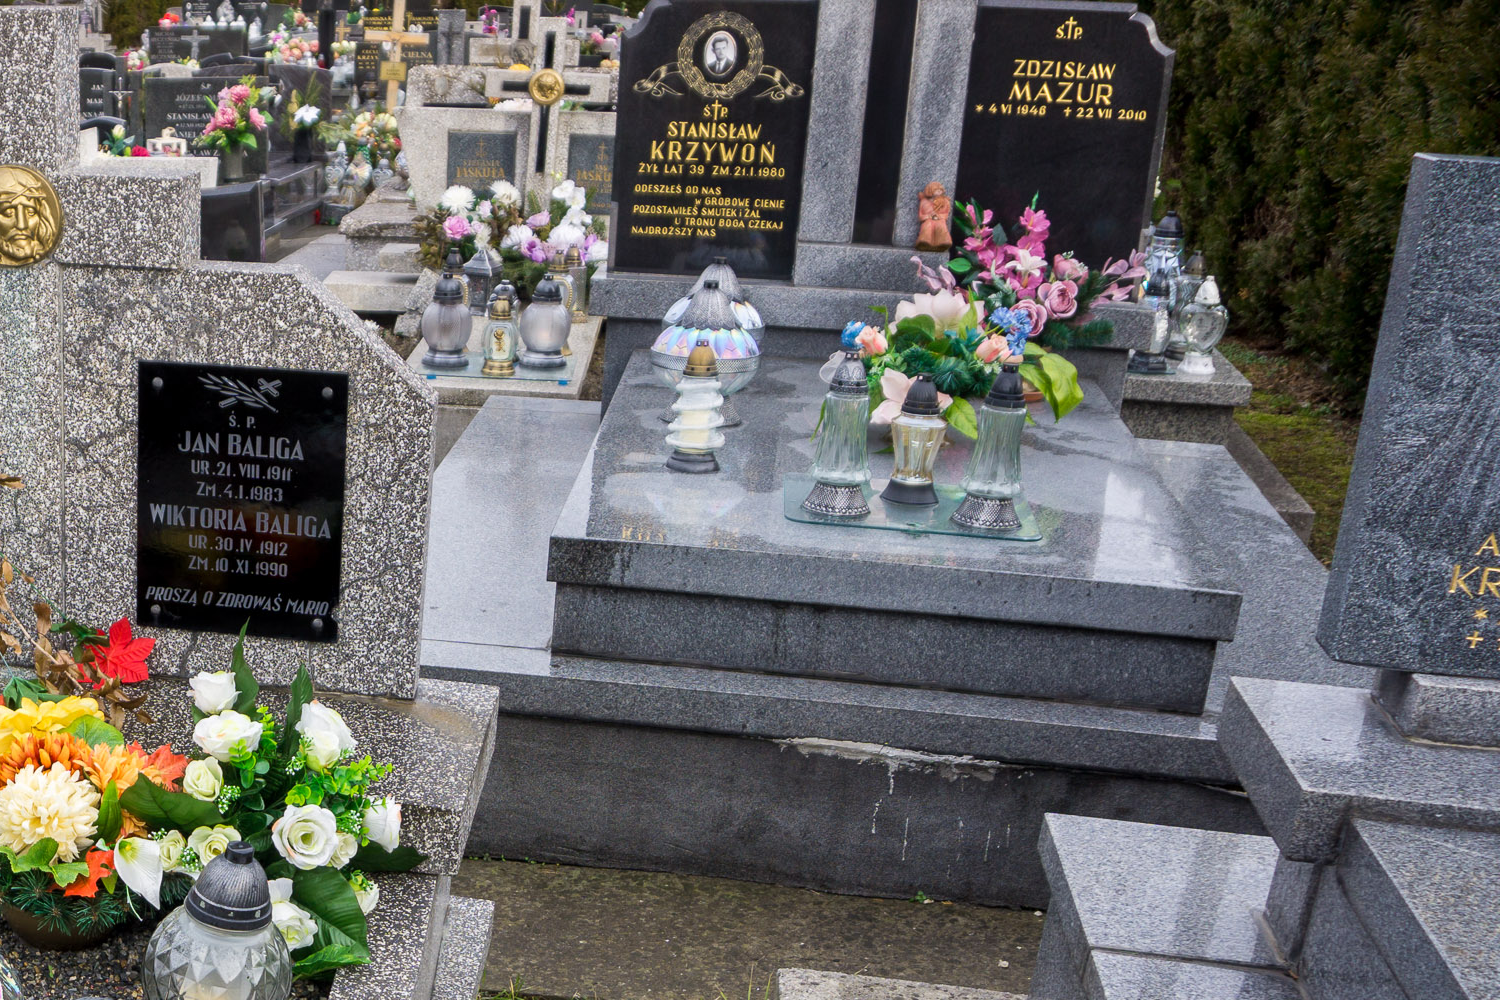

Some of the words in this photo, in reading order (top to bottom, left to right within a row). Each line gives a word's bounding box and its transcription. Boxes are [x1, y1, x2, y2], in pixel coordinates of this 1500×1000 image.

[1013, 59, 1116, 80] ZDZISŁAW
[1008, 80, 1113, 105] MAZUR
[1001, 103, 1012, 115] VI
[1017, 104, 1047, 116] 1946
[1076, 107, 1094, 118] 22
[1098, 107, 1113, 119] VII
[1117, 109, 1147, 121] 2010
[667, 120, 762, 140] STANISŁAW
[651, 140, 776, 164] KRZYWOŃ
[638, 162, 659, 174] ŻYŁ
[664, 164, 684, 175] LAT
[689, 164, 705, 175] 39
[634, 183, 682, 194] ODESZŁEŚ
[685, 185, 699, 194] OD
[701, 186, 722, 196] NAS
[632, 204, 699, 216] POZOSTAWIŁEŚ
[701, 207, 738, 218] SMUTEK
[743, 206, 761, 218] ŻAL
[704, 196, 750, 208] GROBOWE
[754, 198, 786, 209] CIENIE
[631, 225, 694, 236] NAJDROŻSZY
[696, 227, 717, 237] NAS
[674, 217, 681, 226] U
[684, 216, 716, 227] TRONU
[718, 218, 745, 228] BOGA
[748, 219, 784, 230] CZEKAJ
[177, 430, 220, 455] JAN
[228, 433, 305, 461] BALIGA
[150, 503, 247, 532] WIKTORIA
[255, 511, 332, 539] BALIGA
[145, 586, 197, 607] PROSZĄ
[202, 590, 214, 605] O
[216, 592, 283, 613] ZDROWAŚ
